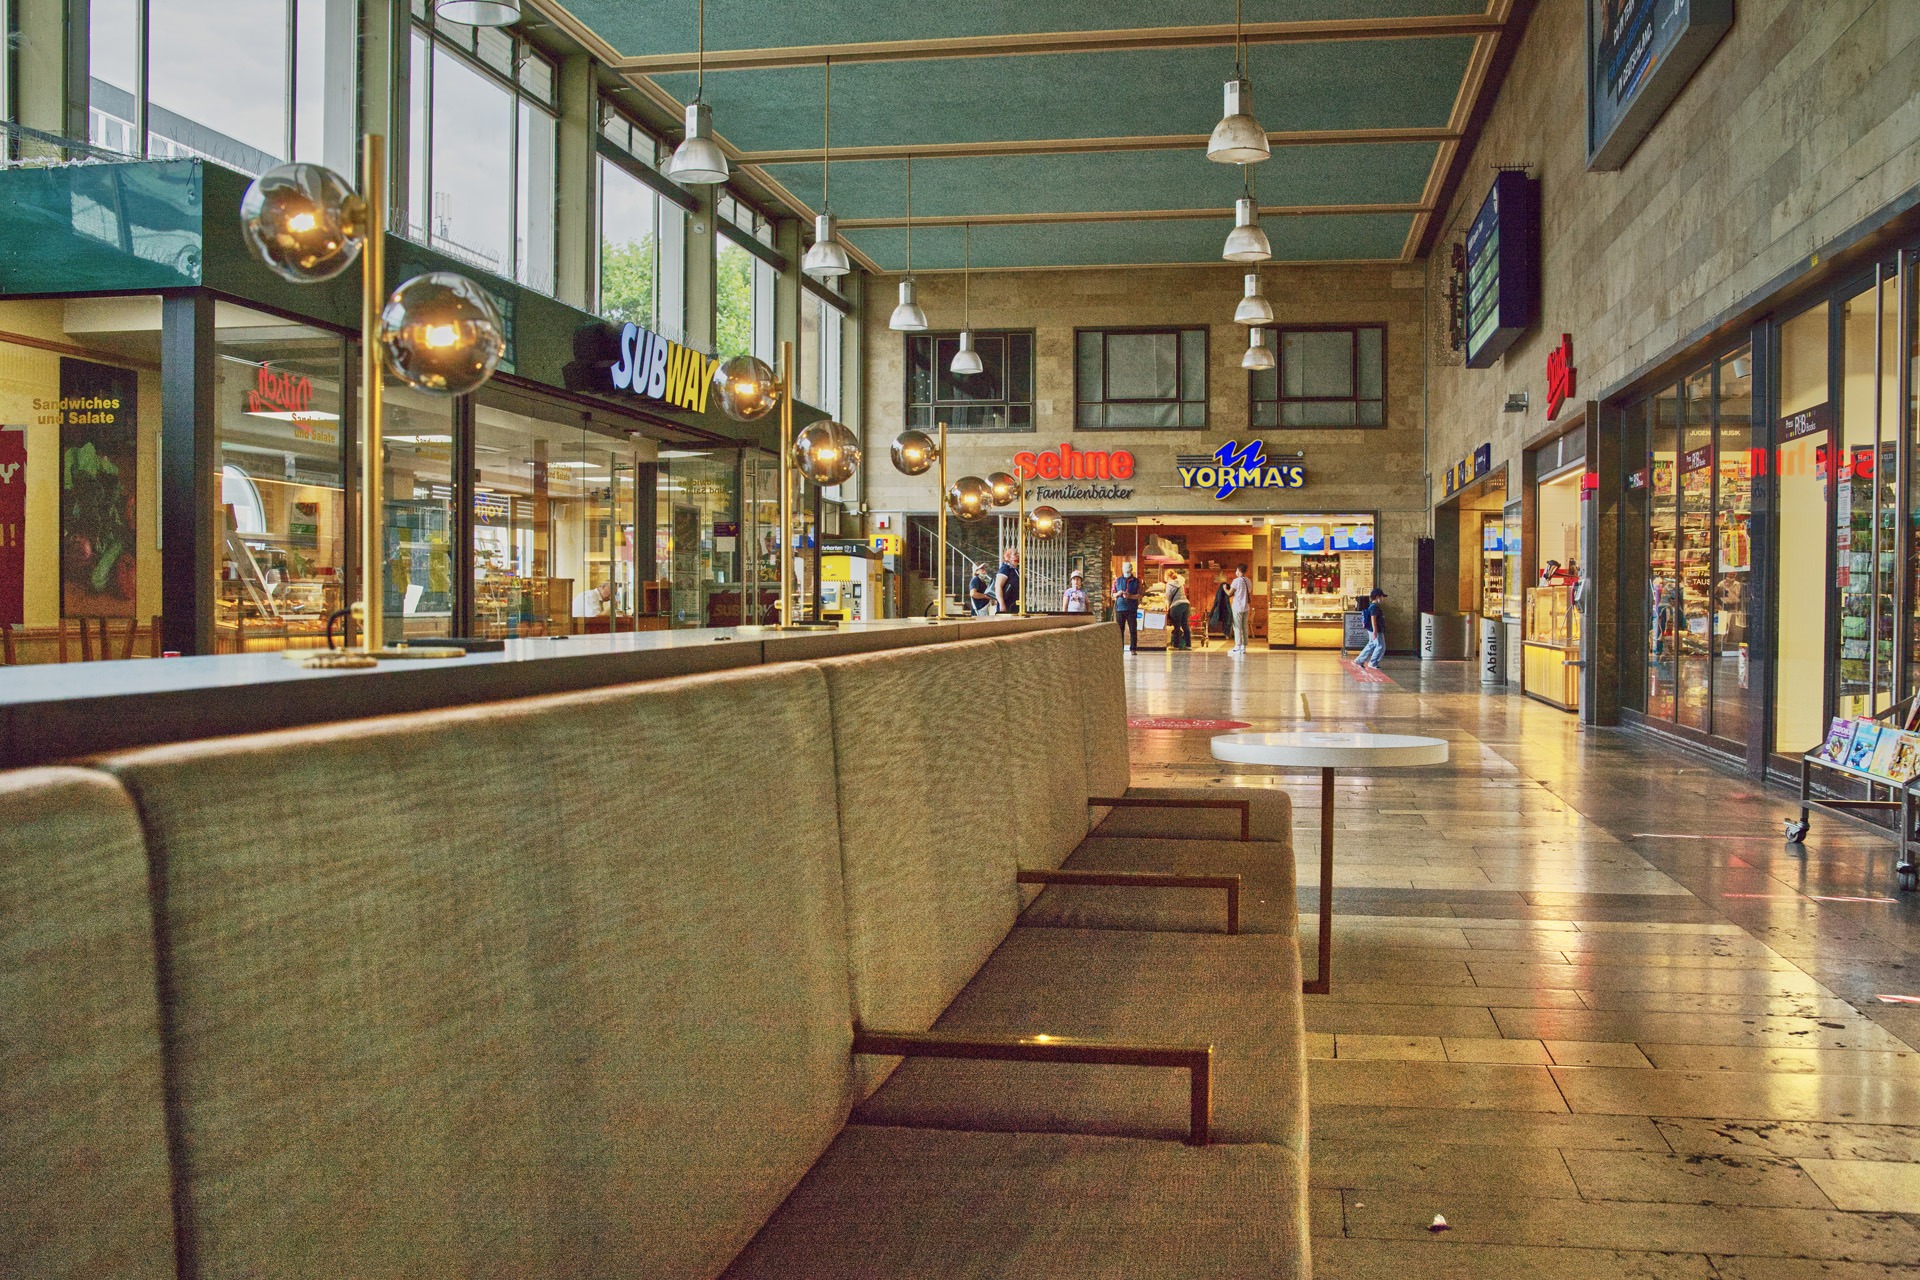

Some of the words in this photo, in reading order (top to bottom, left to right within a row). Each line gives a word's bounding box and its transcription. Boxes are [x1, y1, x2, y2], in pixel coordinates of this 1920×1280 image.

[610, 321, 719, 414] SUBWAY
[32, 396, 120, 411] Sandwiches
[38, 411, 64, 425] und
[68, 411, 115, 425] Salate
[1806, 421, 1816, 432] Books
[311, 430, 336, 443] Salate
[1013, 443, 1134, 480] sehne
[1177, 466, 1304, 488] YORMA'S
[1036, 483, 1134, 500] Familienbäcker
[1425, 625, 1433, 653] Abfall
[1487, 636, 1497, 674] Abfall
